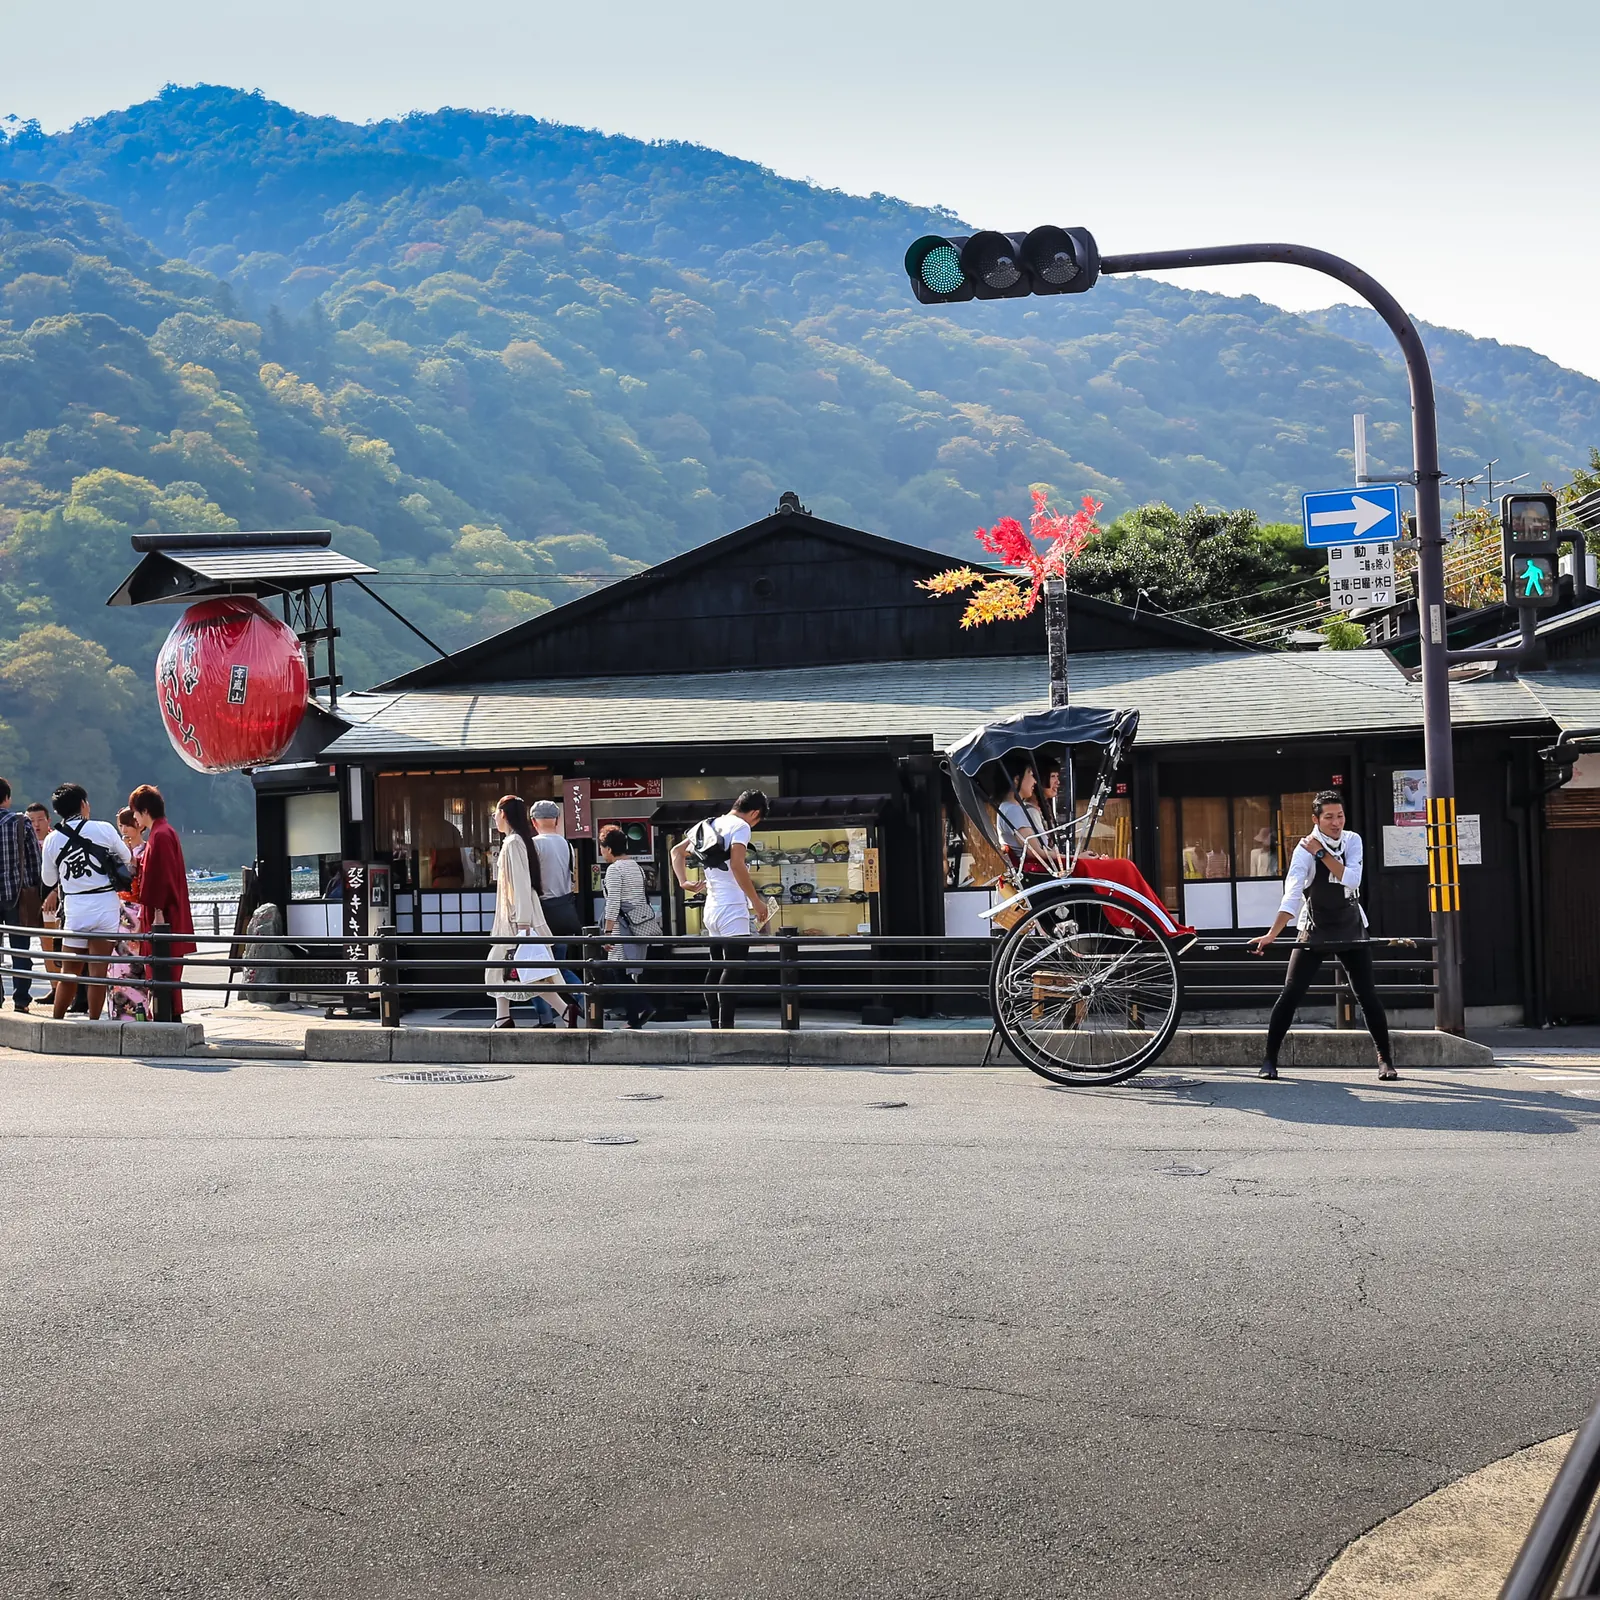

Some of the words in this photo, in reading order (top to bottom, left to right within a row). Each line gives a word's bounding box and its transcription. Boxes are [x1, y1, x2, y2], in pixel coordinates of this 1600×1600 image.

[1331, 544, 1390, 560] 自動車
[1374, 592, 1386, 602] 17
[230, 667, 245, 702] 京嵐山
